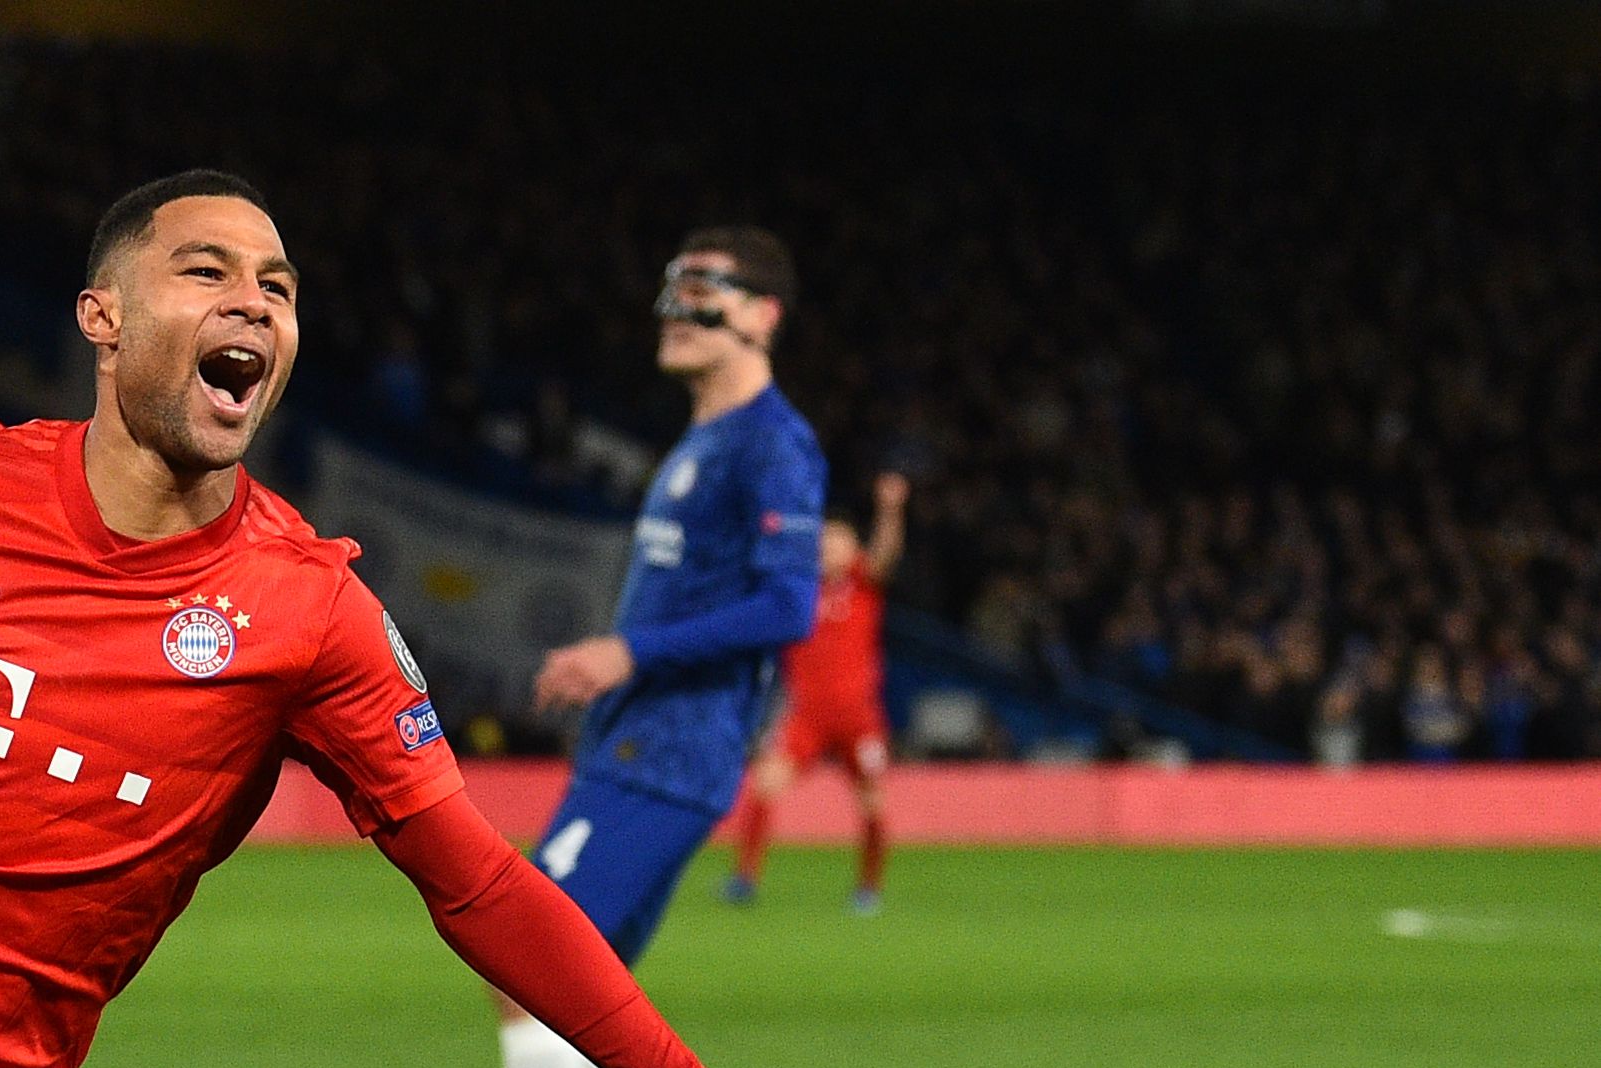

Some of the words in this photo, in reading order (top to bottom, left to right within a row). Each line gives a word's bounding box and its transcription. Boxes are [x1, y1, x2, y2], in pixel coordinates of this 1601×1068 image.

[172, 616, 189, 633] FC
[190, 612, 230, 647] BAYERN
[542, 817, 593, 881] 4
